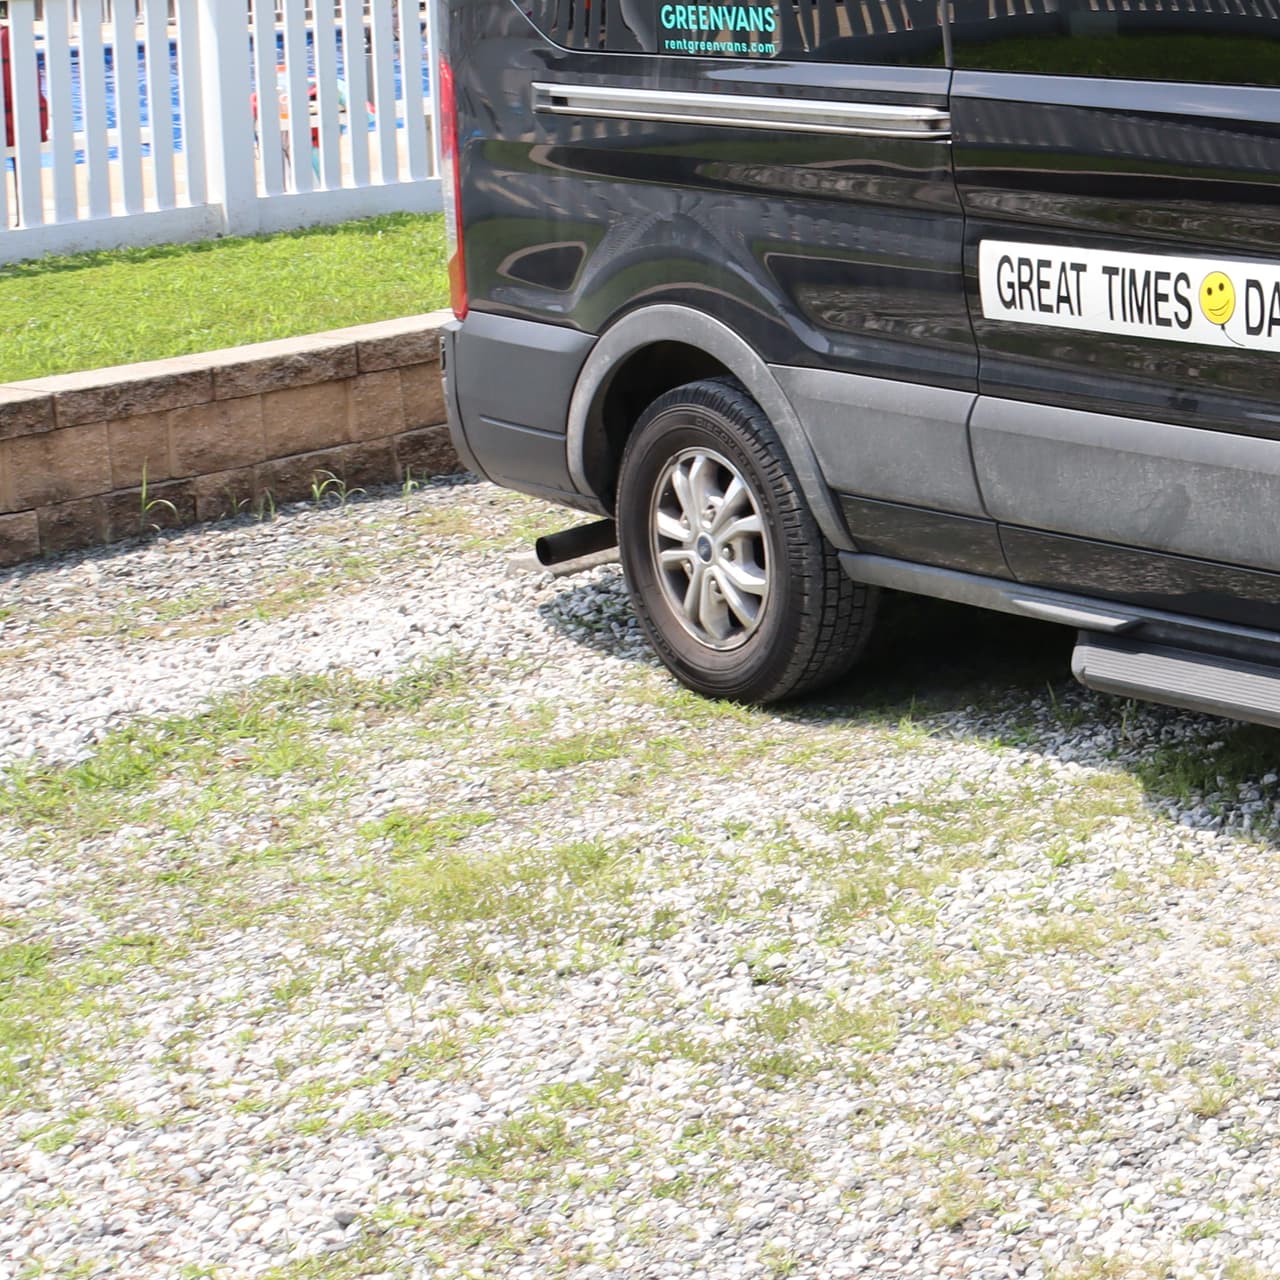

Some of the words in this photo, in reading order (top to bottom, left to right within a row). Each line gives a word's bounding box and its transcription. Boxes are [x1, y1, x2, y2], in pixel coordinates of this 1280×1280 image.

[660, 4, 776, 32] GREENVANS
[664, 38, 776, 54] rentgreenvans.com
[997, 255, 1086, 317] GREAT
[1102, 266, 1193, 330] TIMES
